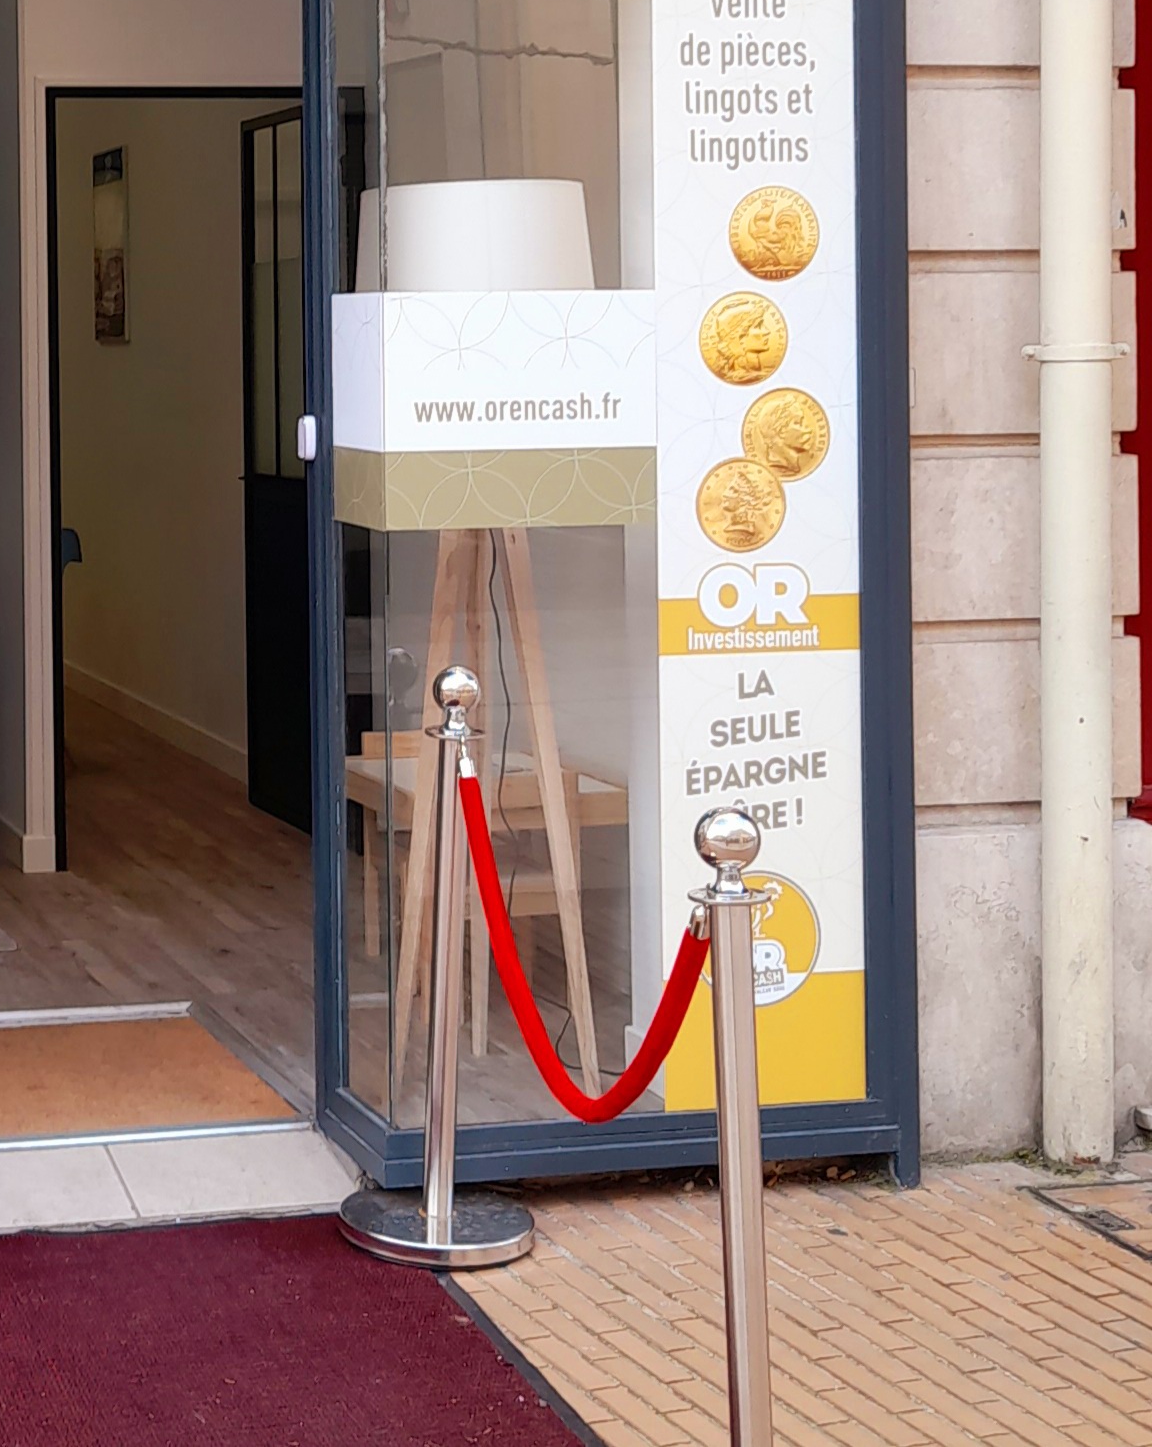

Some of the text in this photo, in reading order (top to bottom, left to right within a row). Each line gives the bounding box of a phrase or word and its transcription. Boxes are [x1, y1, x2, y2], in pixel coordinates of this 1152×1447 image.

[679, 32, 816, 75] de pièces,
[685, 80, 814, 123] lingots et
[689, 128, 809, 171] lingotins
[413, 392, 622, 424] www.orencash.fr
[699, 562, 811, 628] OR
[687, 624, 820, 651] Investissement
[737, 669, 775, 700] LA
[709, 710, 801, 748] SEULE
[685, 750, 828, 797] ÉPARGNE
